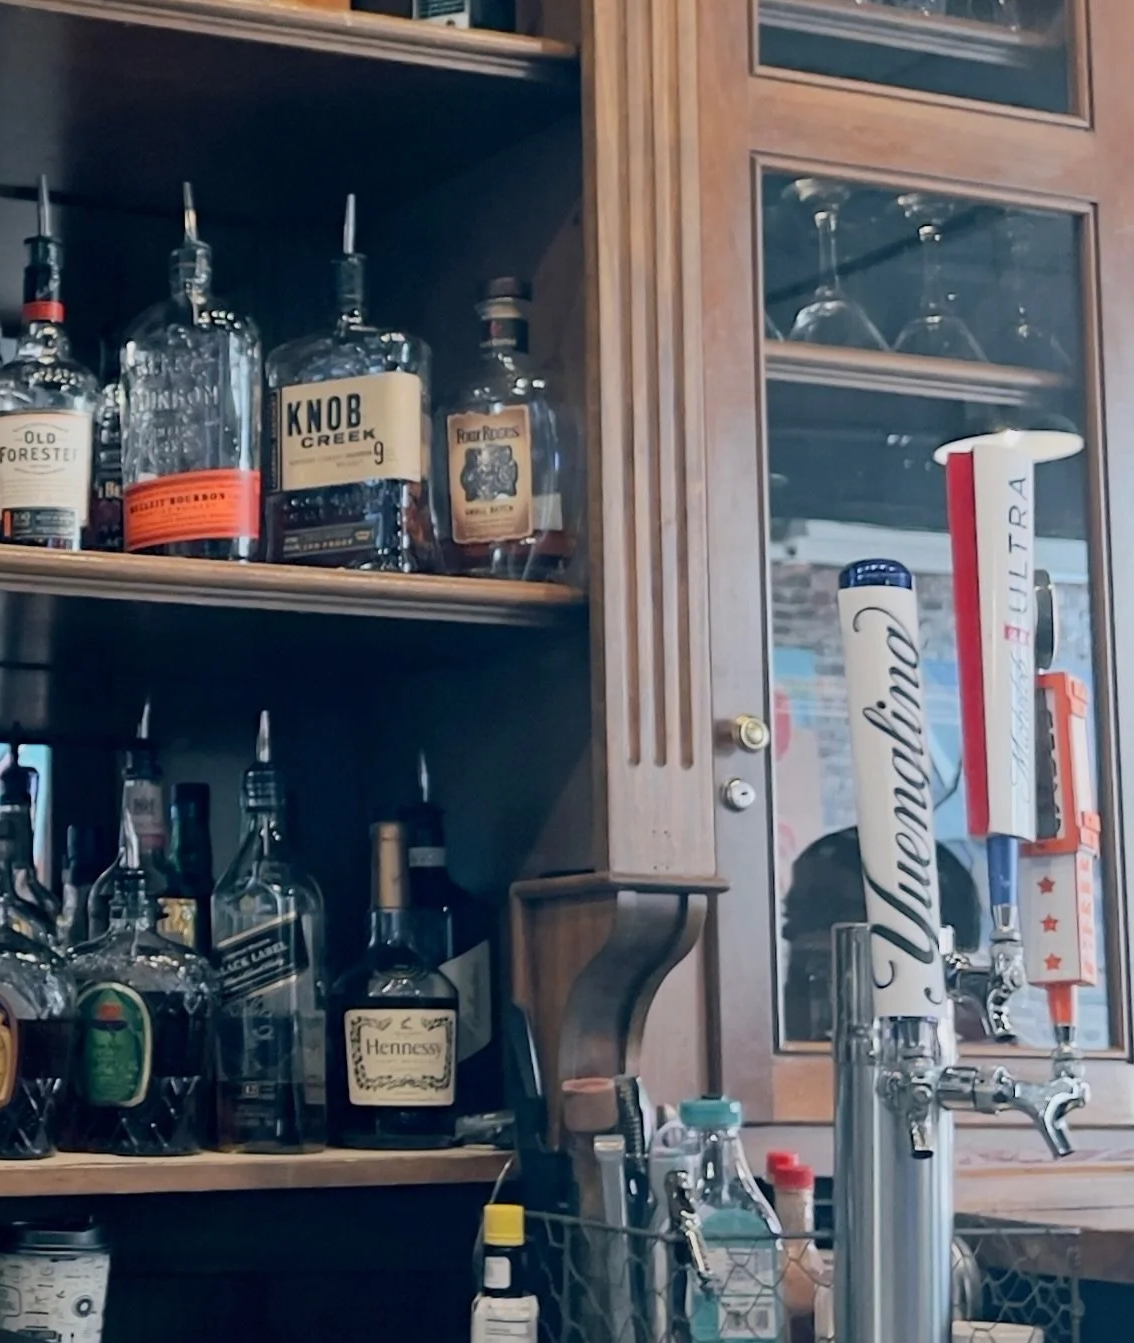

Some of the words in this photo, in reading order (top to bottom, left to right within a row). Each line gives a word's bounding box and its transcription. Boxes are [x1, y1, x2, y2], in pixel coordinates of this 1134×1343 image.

[286, 392, 362, 437] KNOB
[23, 430, 56, 445] OLD
[300, 427, 377, 449] CREEK
[373, 440, 385, 466] 9
[1006, 475, 1030, 616] ULTRA
[852, 606, 943, 1005] Yuengling
[366, 1038, 443, 1061] Hennessy
